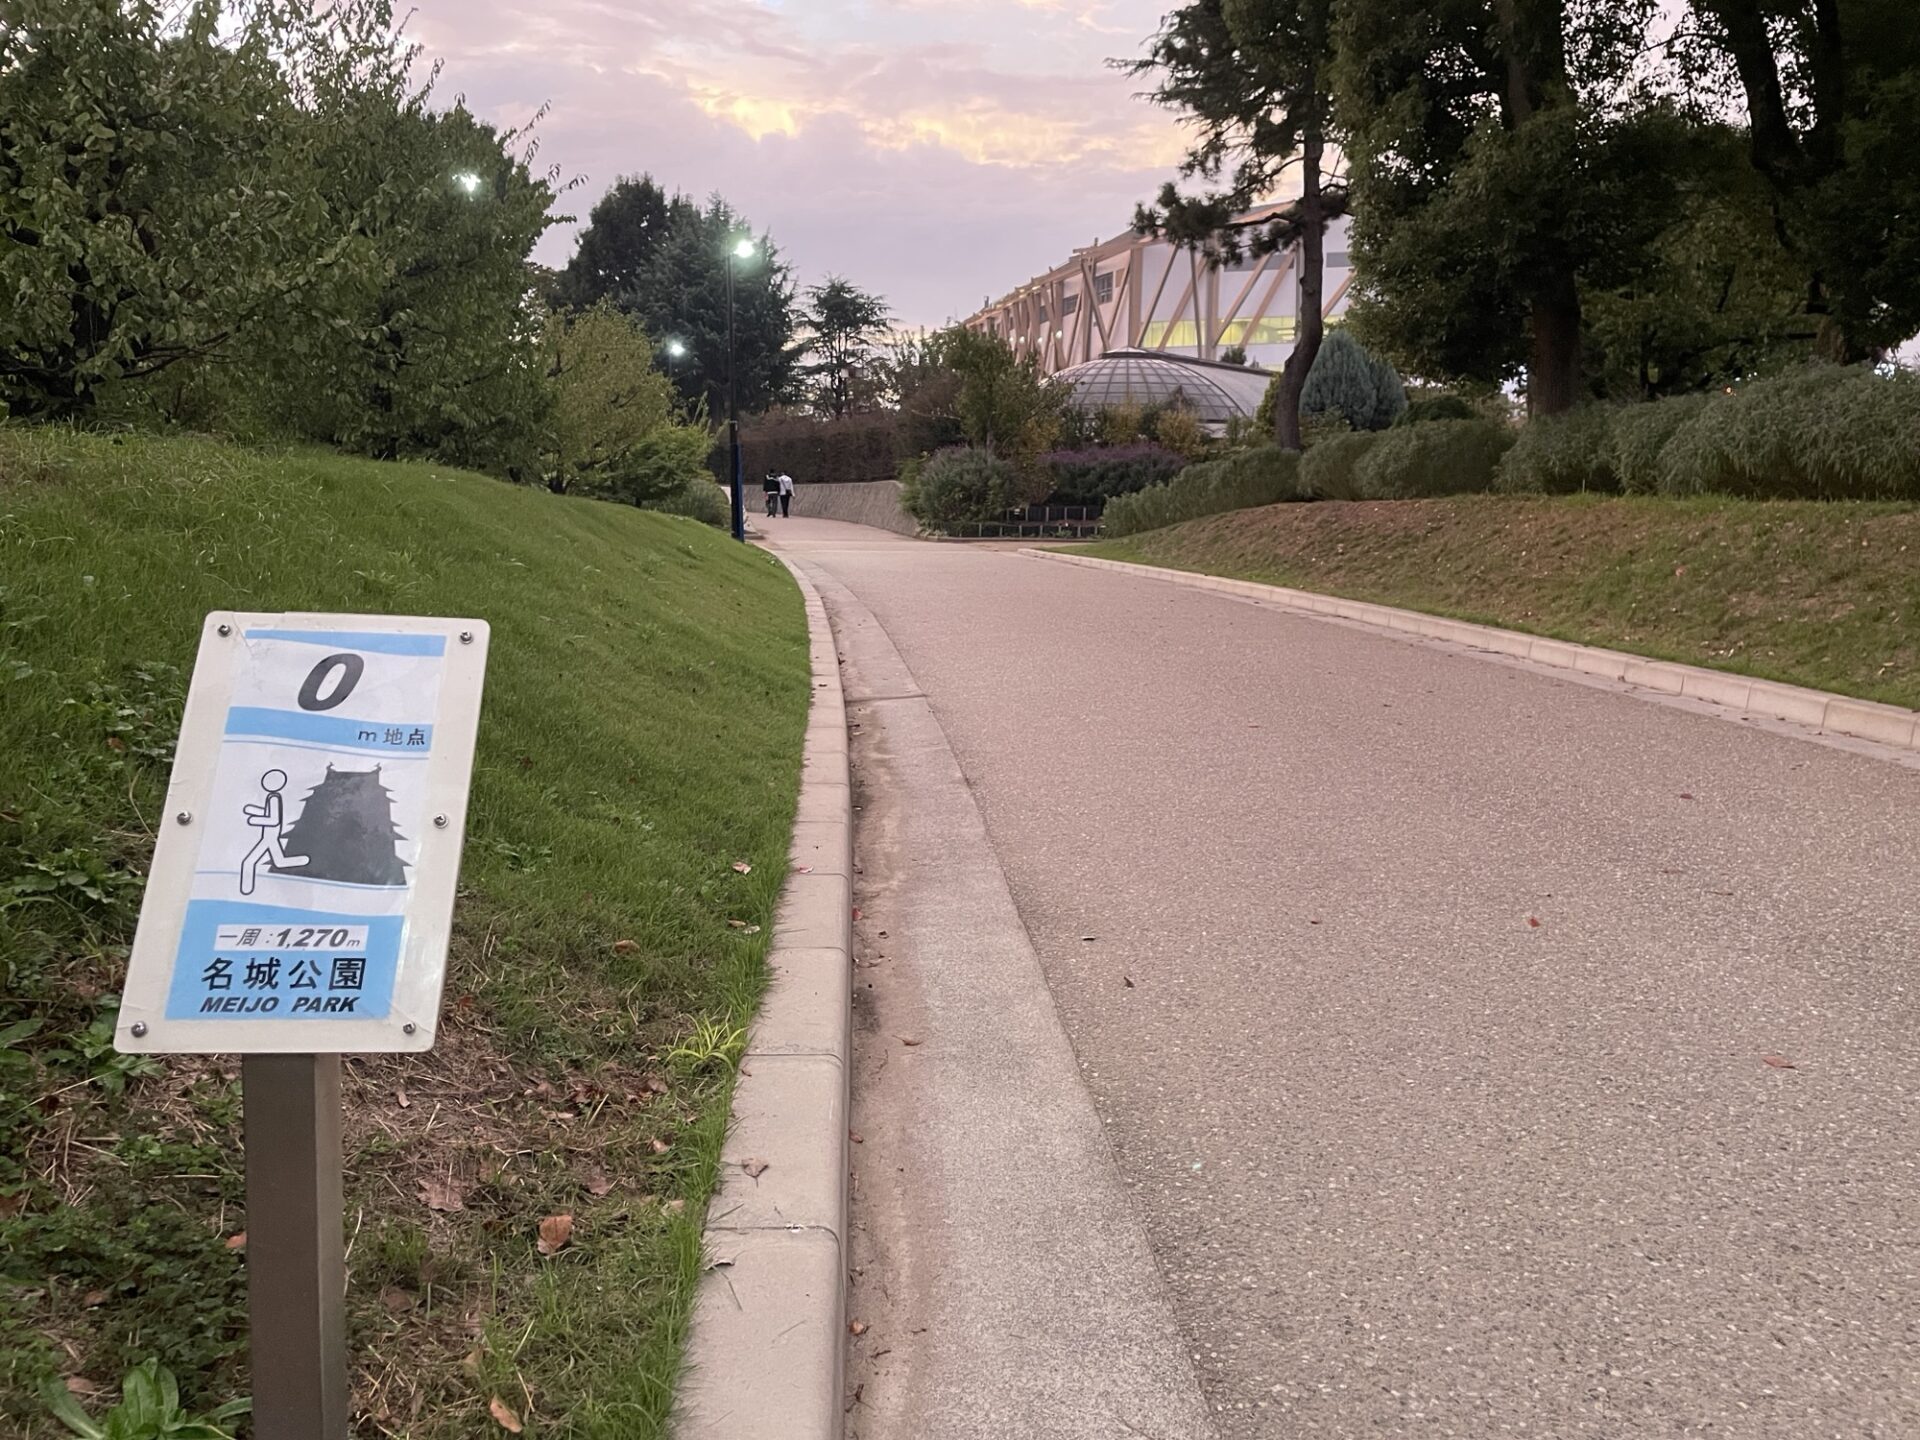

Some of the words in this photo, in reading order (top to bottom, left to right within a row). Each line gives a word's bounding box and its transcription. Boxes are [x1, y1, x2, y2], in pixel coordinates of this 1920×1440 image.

[297, 653, 364, 711] 0
[202, 957, 366, 991] 名城公園
[200, 996, 279, 1013] MEIJO
[291, 997, 361, 1013] PARK
